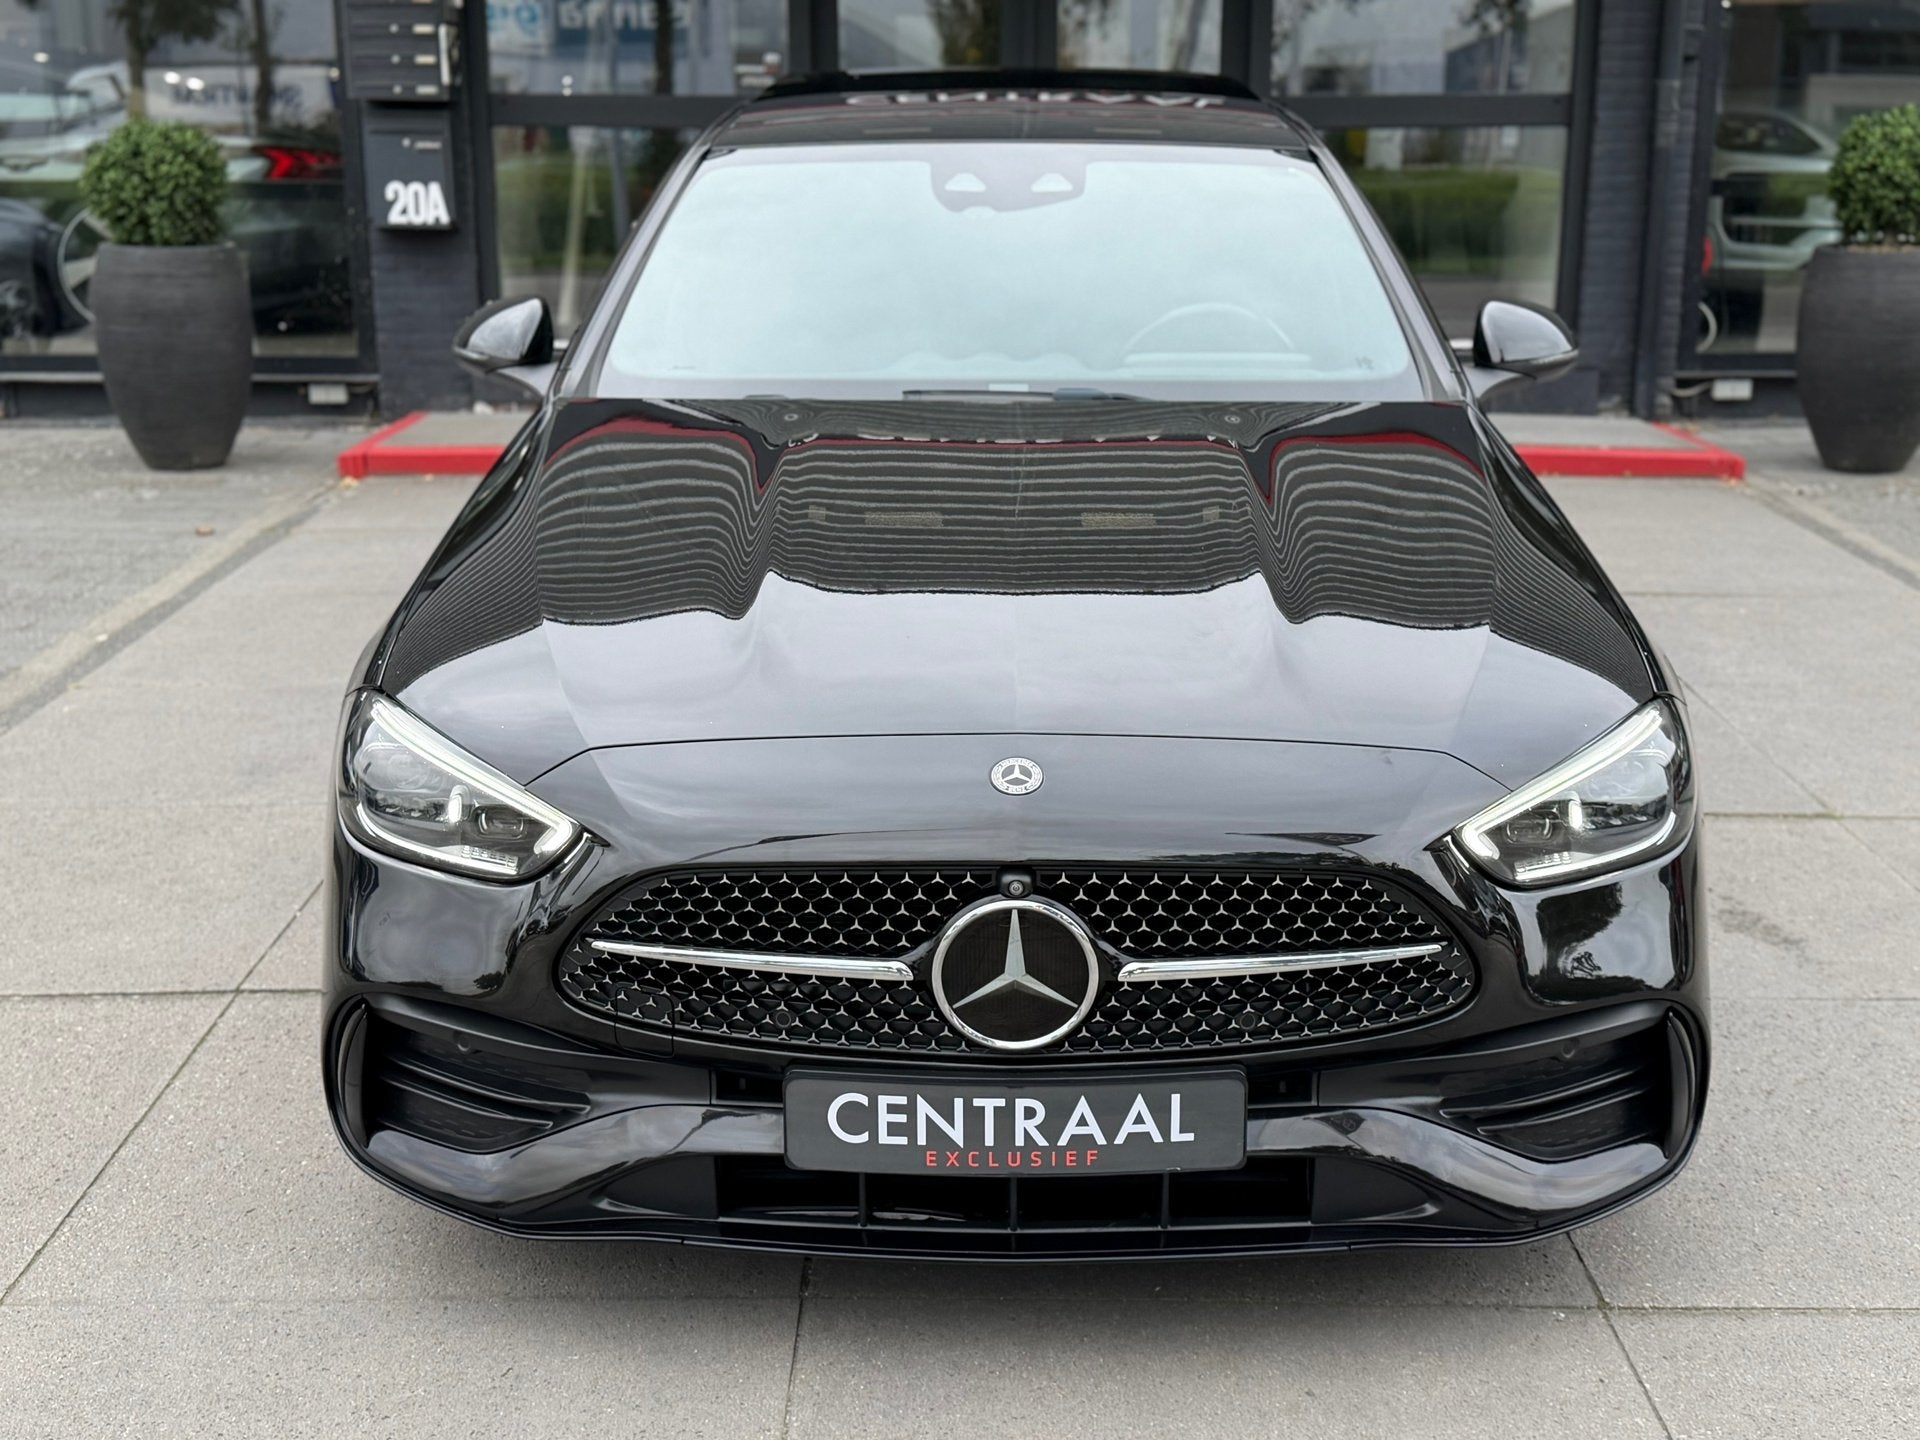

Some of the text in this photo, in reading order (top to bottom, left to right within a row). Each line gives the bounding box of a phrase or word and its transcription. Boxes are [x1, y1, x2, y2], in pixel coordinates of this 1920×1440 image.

[384, 180, 450, 225] 20A
[826, 1092, 1196, 1148] CENTRAAL
[925, 1150, 1100, 1168] EXCLUSIEF
